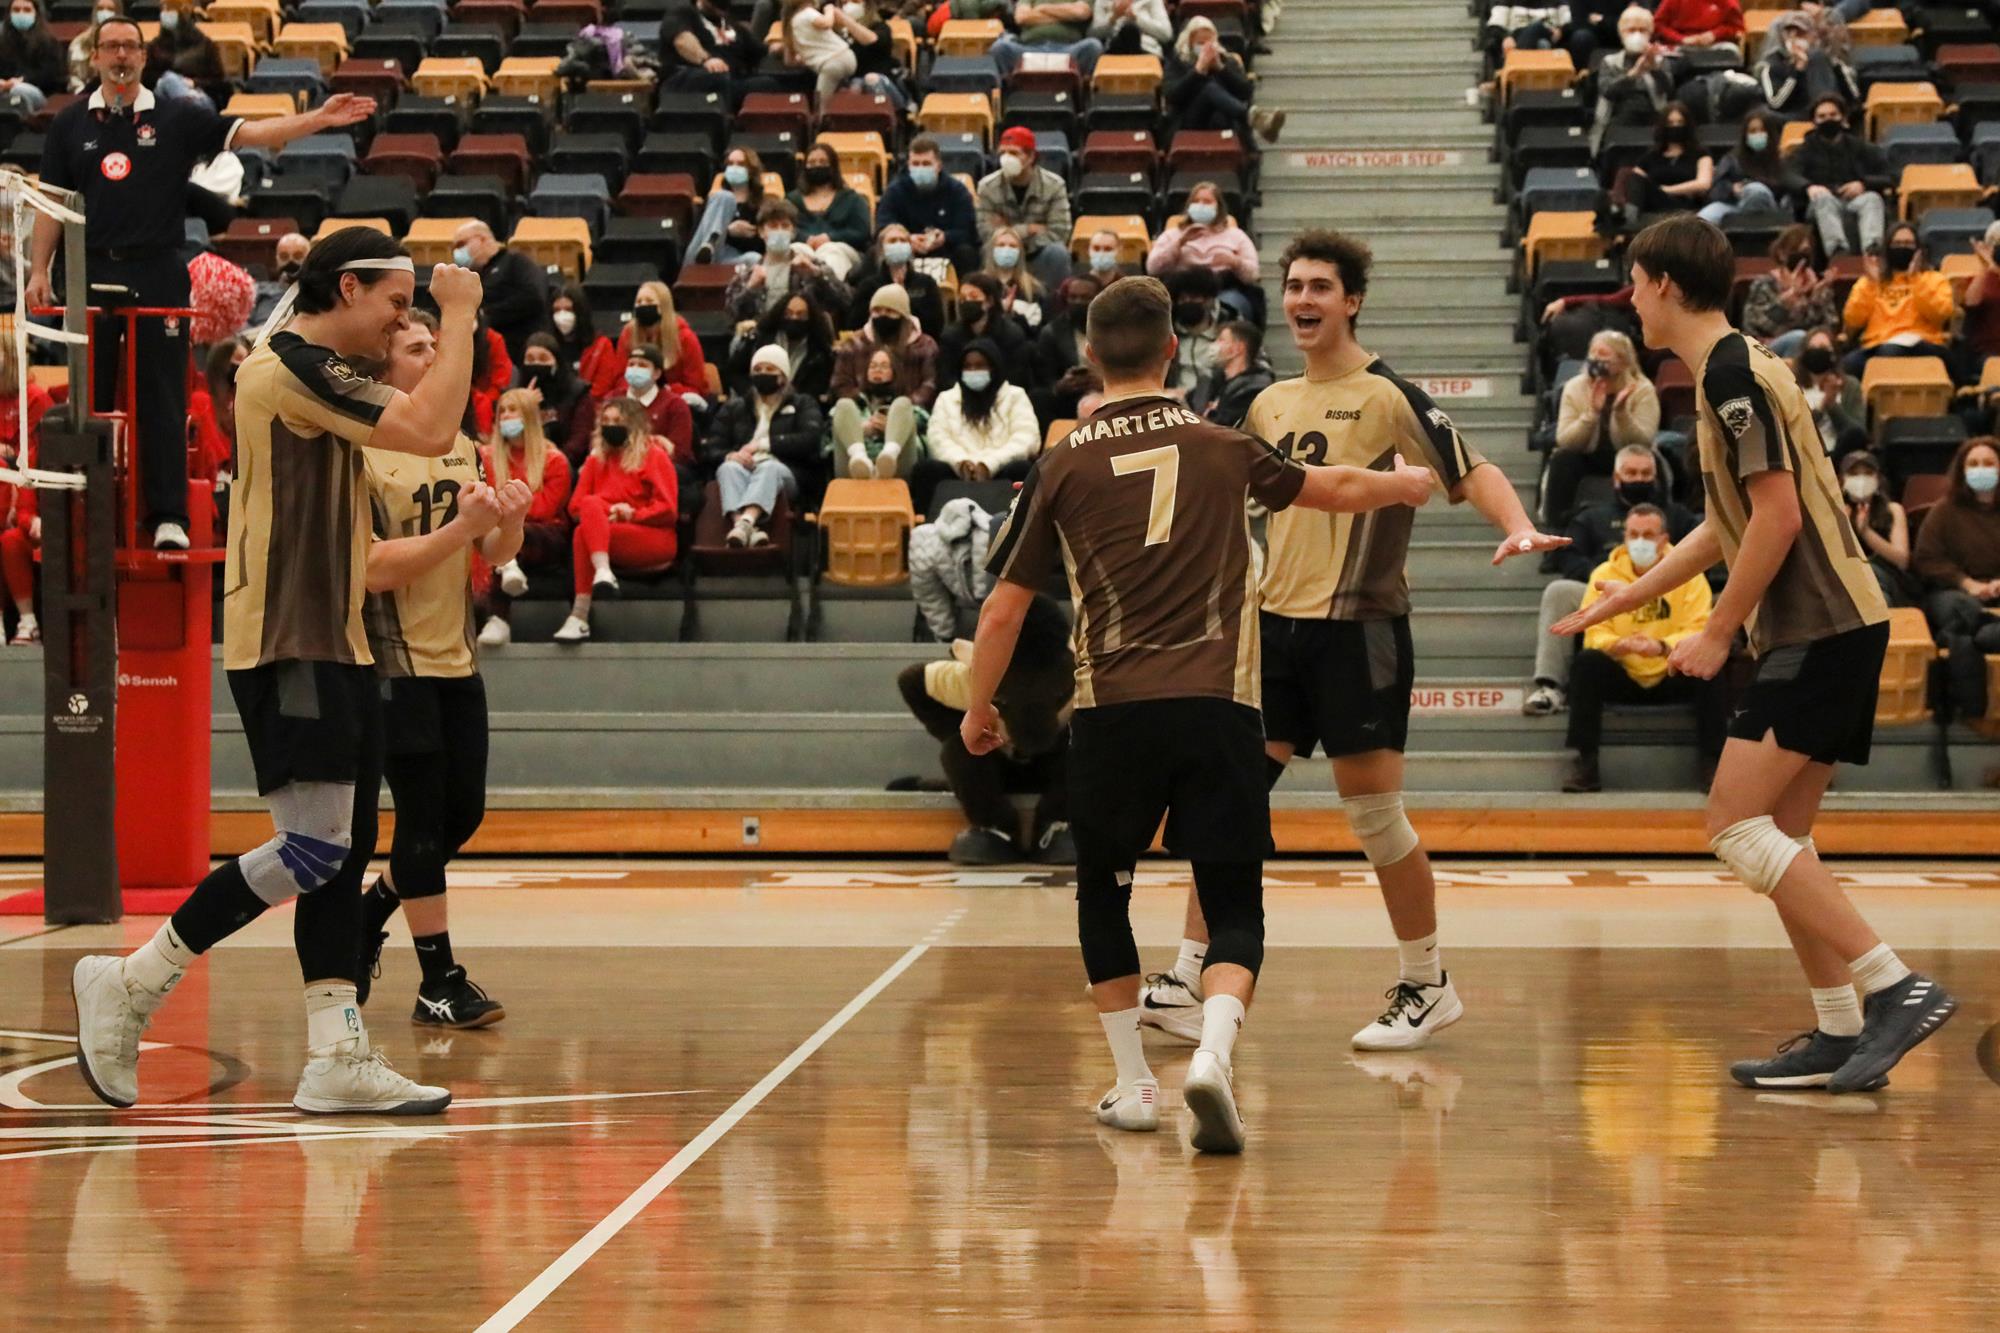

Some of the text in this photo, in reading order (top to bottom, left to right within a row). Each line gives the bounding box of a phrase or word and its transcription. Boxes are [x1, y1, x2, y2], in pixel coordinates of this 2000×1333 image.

[1305, 153, 1445, 167] WATCH YOUR STEP
[1428, 379, 1472, 395] STEP
[1324, 409, 1362, 421] BISONS
[1069, 407, 1201, 449] MARTENS
[1109, 444, 1180, 547] 7
[412, 479, 462, 536] 12
[131, 675, 178, 687] Senoh
[1410, 690, 1504, 707] OUR STEP
